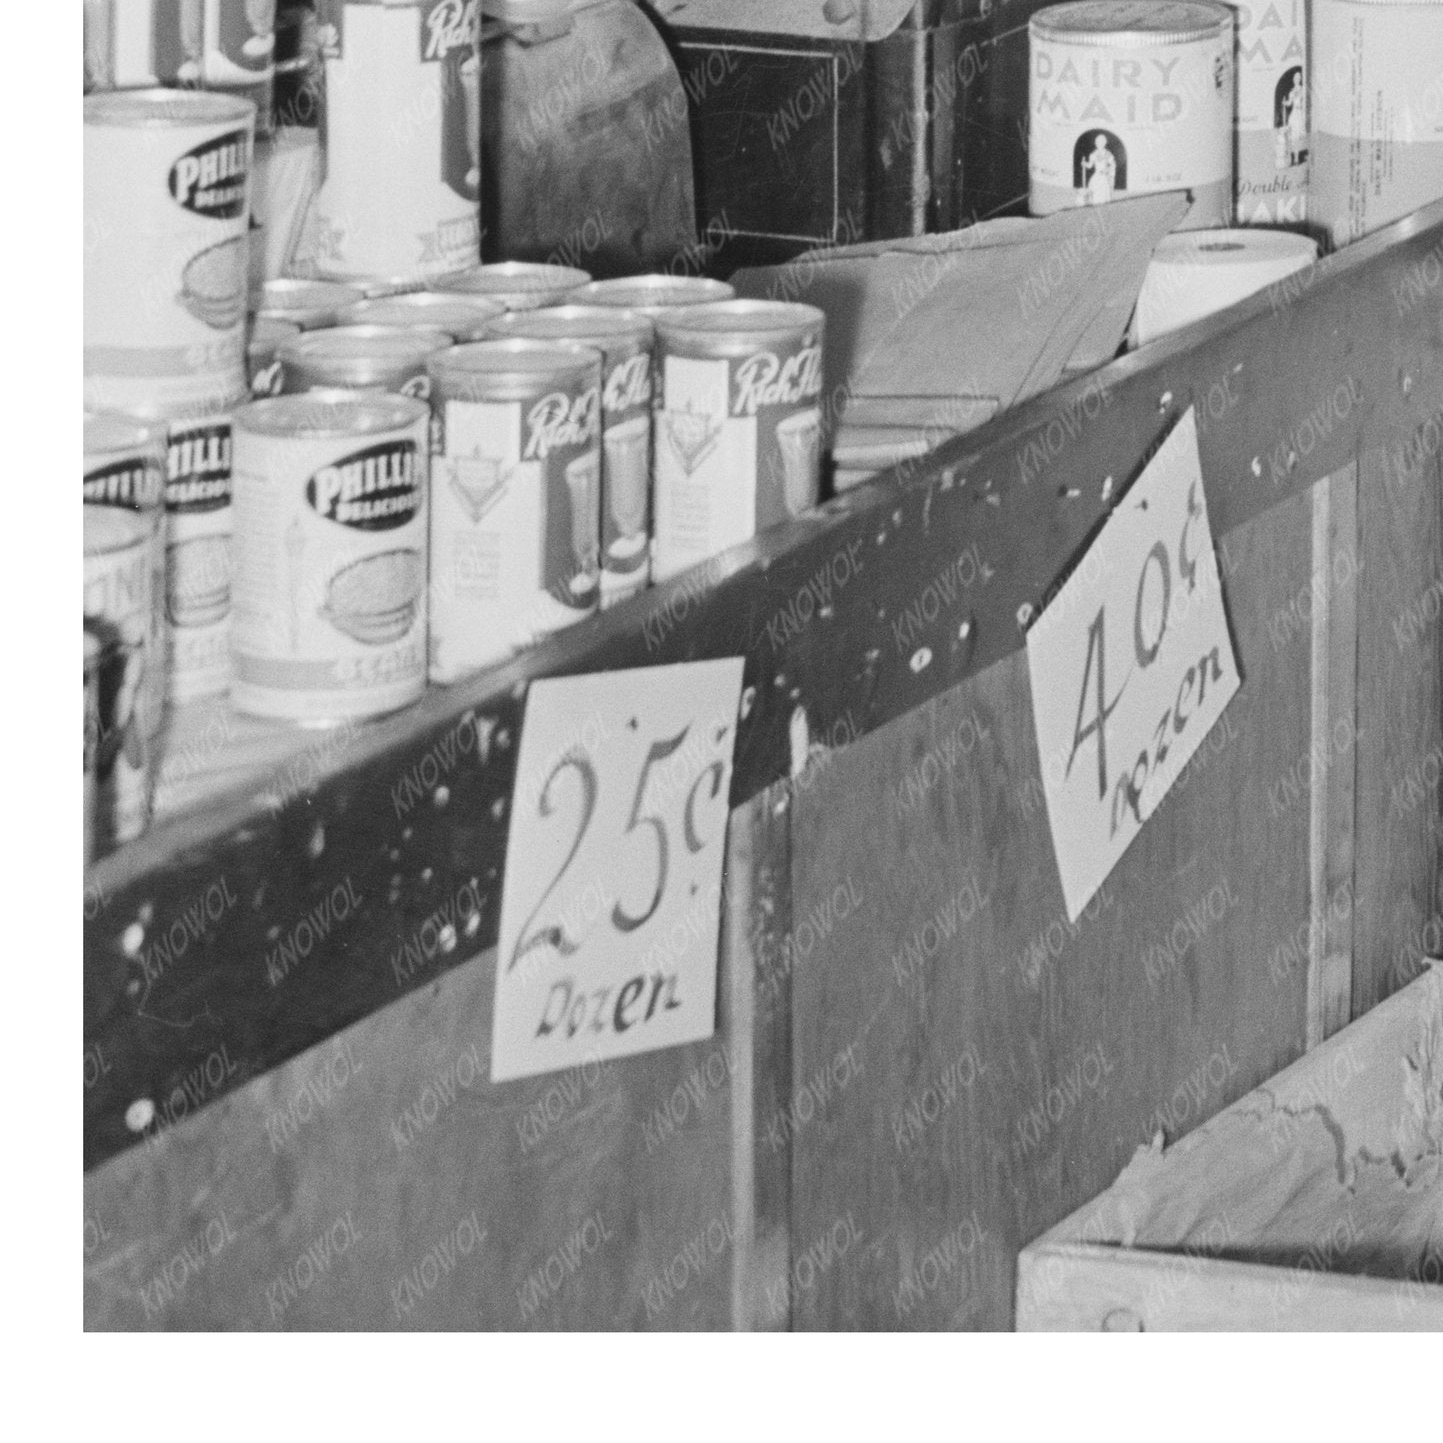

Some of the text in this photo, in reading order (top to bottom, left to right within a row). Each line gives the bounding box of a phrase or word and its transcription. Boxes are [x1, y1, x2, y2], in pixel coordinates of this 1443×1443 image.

[1036, 50, 1181, 89] DAIRY
[1036, 88, 1183, 123] MAID
[1065, 478, 1201, 802] 40¢
[508, 717, 729, 972] 25¢
[535, 974, 682, 1039] Dozen
